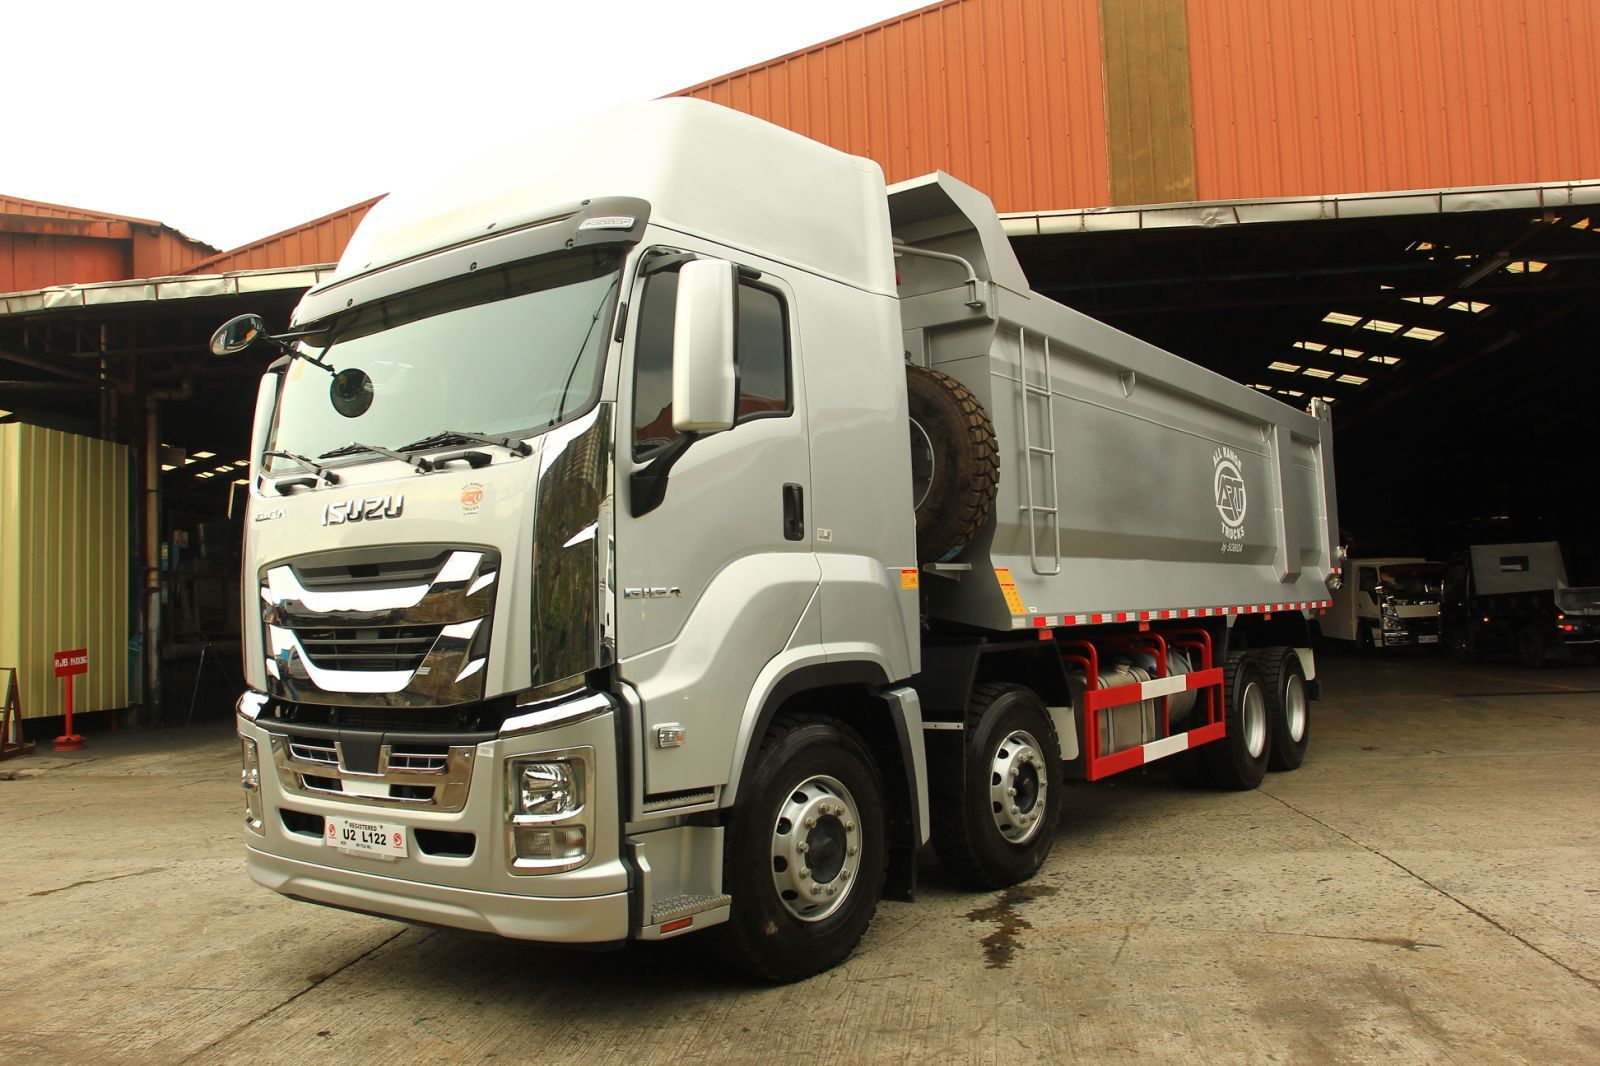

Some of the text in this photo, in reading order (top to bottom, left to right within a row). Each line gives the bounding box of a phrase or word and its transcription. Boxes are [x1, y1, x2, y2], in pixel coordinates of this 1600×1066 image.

[1212, 446, 1242, 472] ALL RANGE
[321, 493, 405, 526] ISUZU
[1221, 521, 1245, 540] TRUCKS
[1220, 541, 1227, 554] by
[55, 658, 69, 668] RJB
[349, 822, 378, 832] REGISTERED
[343, 828, 356, 841] U2
[362, 831, 387, 846] L122
